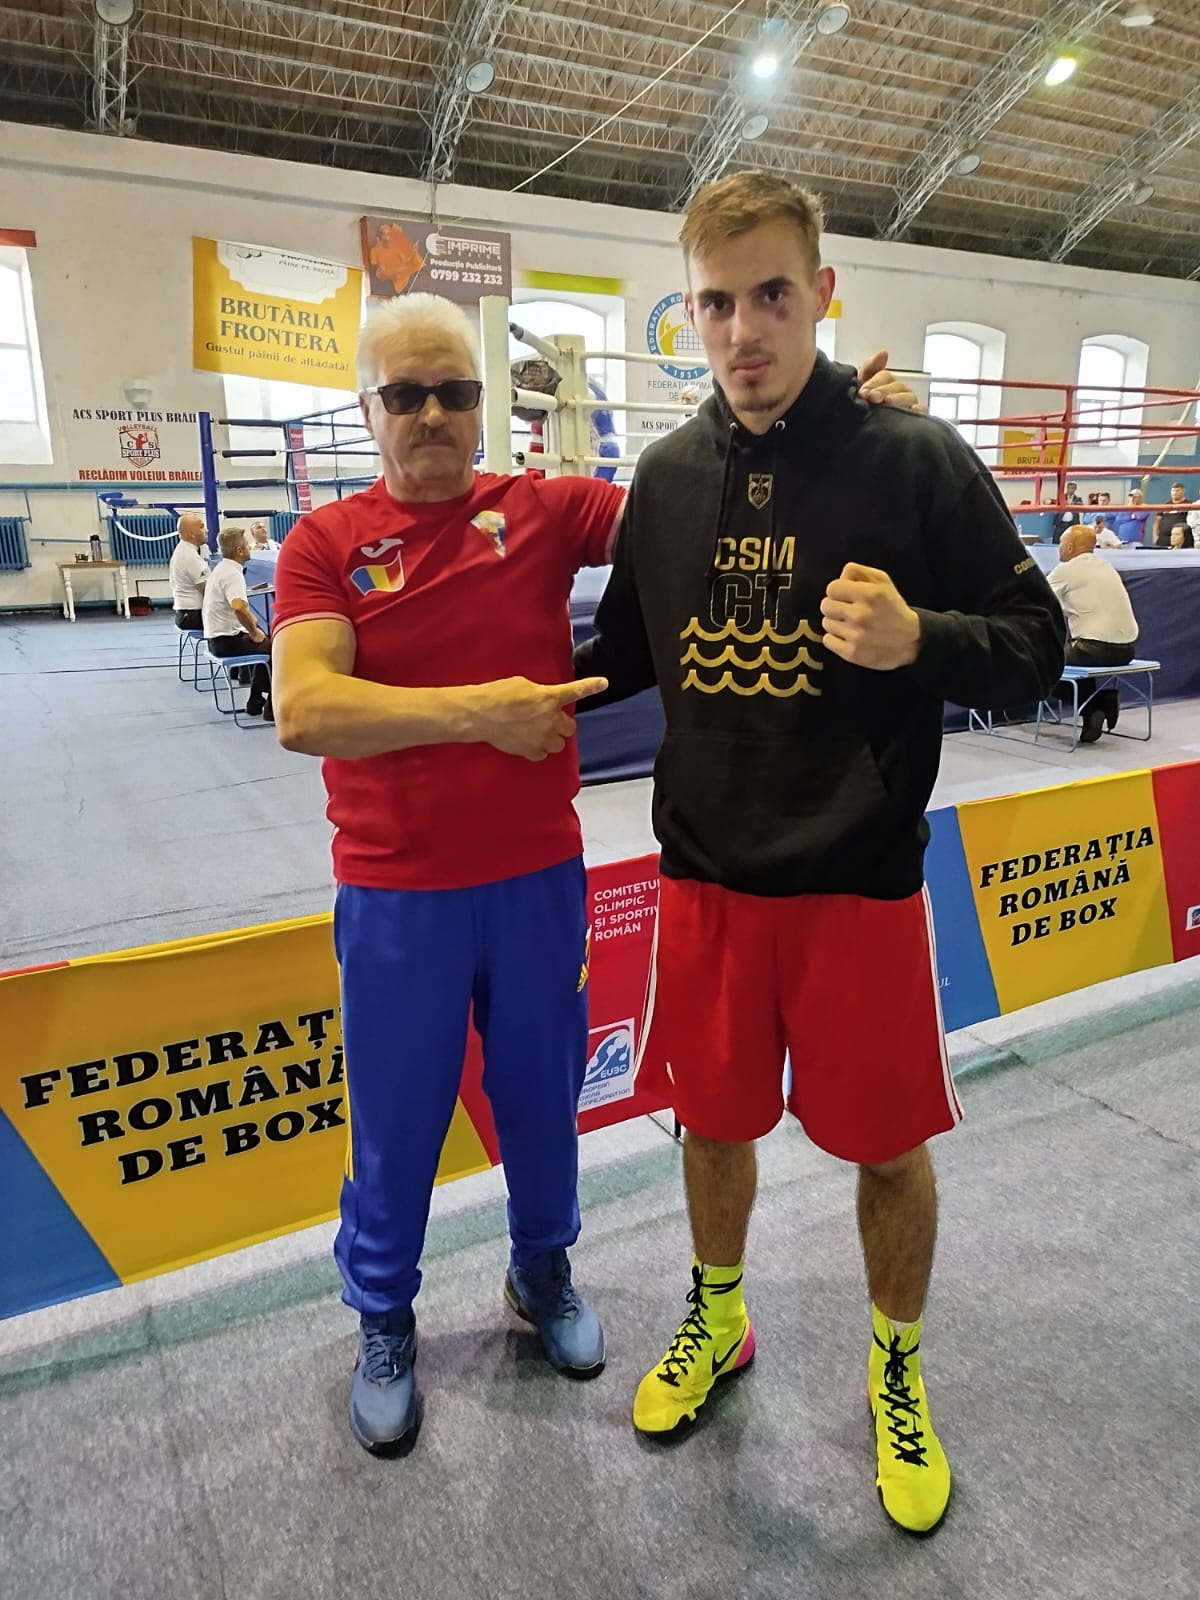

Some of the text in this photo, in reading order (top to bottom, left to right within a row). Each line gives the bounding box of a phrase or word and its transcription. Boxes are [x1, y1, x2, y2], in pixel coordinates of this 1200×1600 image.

[430, 269, 503, 286] 0799 232 232
[220, 319, 340, 354] FRONTERA
[205, 341, 245, 356] Gustul
[283, 354, 297, 365] de
[673, 369, 699, 379] 1931
[72, 409, 92, 420] ACS
[95, 409, 133, 421] SPORT
[136, 411, 163, 422] PLUS
[641, 420, 654, 430] ACS
[130, 470, 167, 481] VOLEIUL
[168, 469, 203, 481] BRĂILE
[714, 536, 796, 571] CSM
[710, 572, 793, 630] CT
[979, 826, 1155, 889] FEDERAȚIA
[998, 858, 1132, 918] ROMÂNĂ
[594, 895, 645, 914] OLIMPIC
[594, 922, 642, 942] ROMÂN
[1011, 897, 1119, 947] DE BOX
[20, 1007, 344, 1109] FEDERAȚ
[117, 1096, 346, 1186] DE BOX
